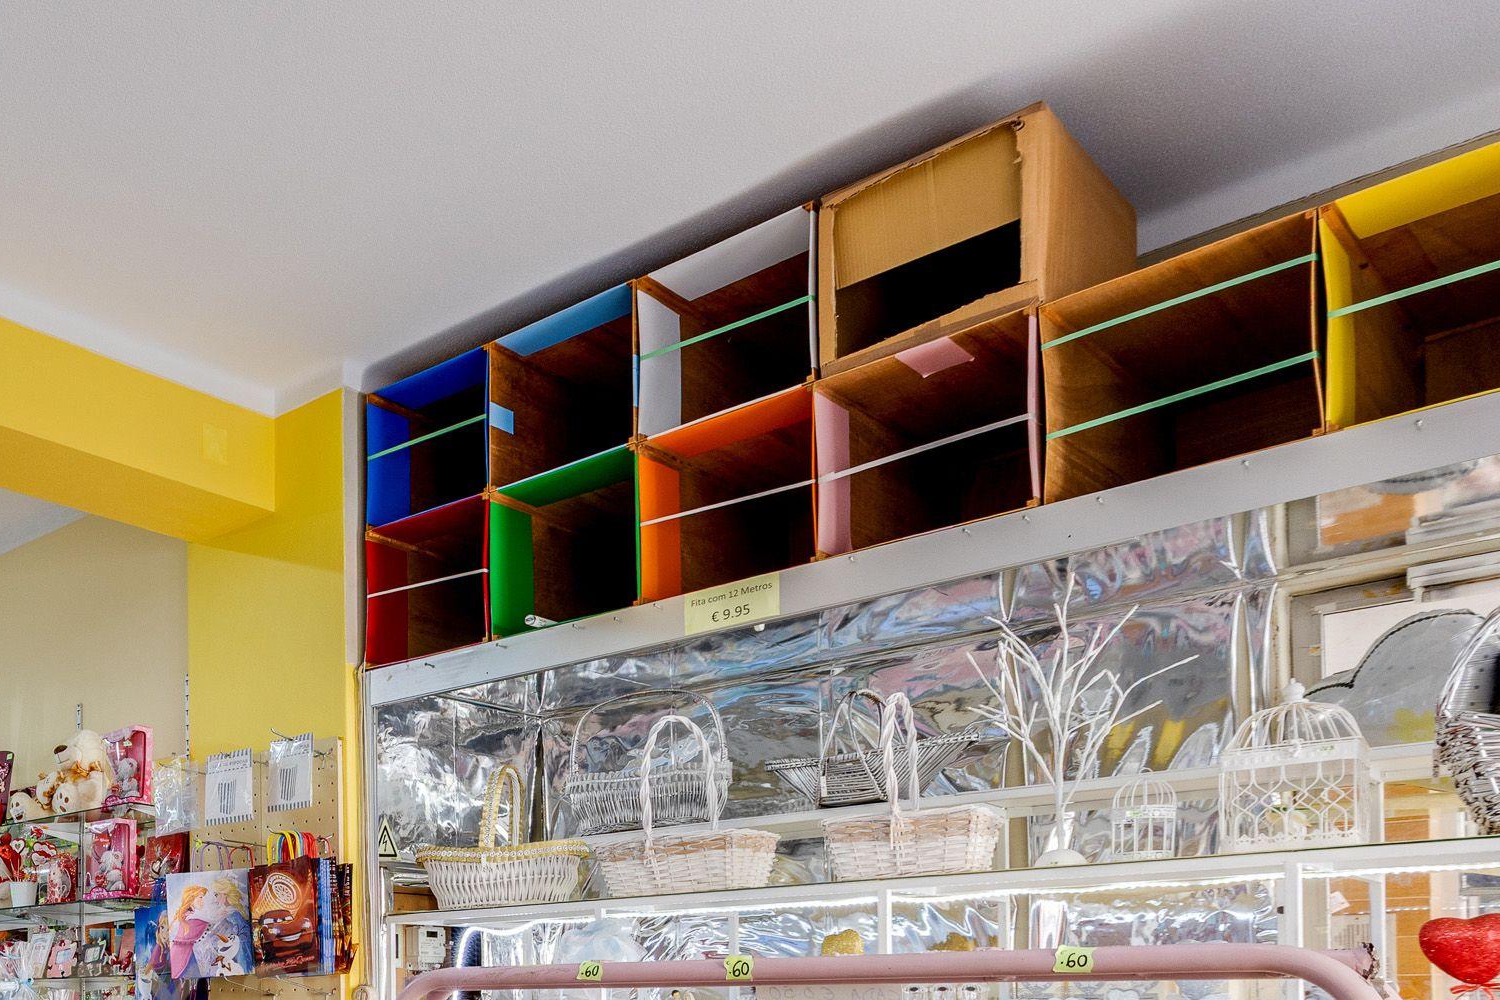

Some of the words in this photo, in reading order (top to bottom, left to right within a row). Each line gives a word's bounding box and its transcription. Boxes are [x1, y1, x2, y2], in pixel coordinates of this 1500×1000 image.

[691, 599, 706, 607] Fita
[708, 595, 726, 604] com
[729, 590, 739, 599] 12
[741, 582, 773, 595] Metros
[711, 611, 720, 622] €
[722, 603, 750, 620] 9.95
